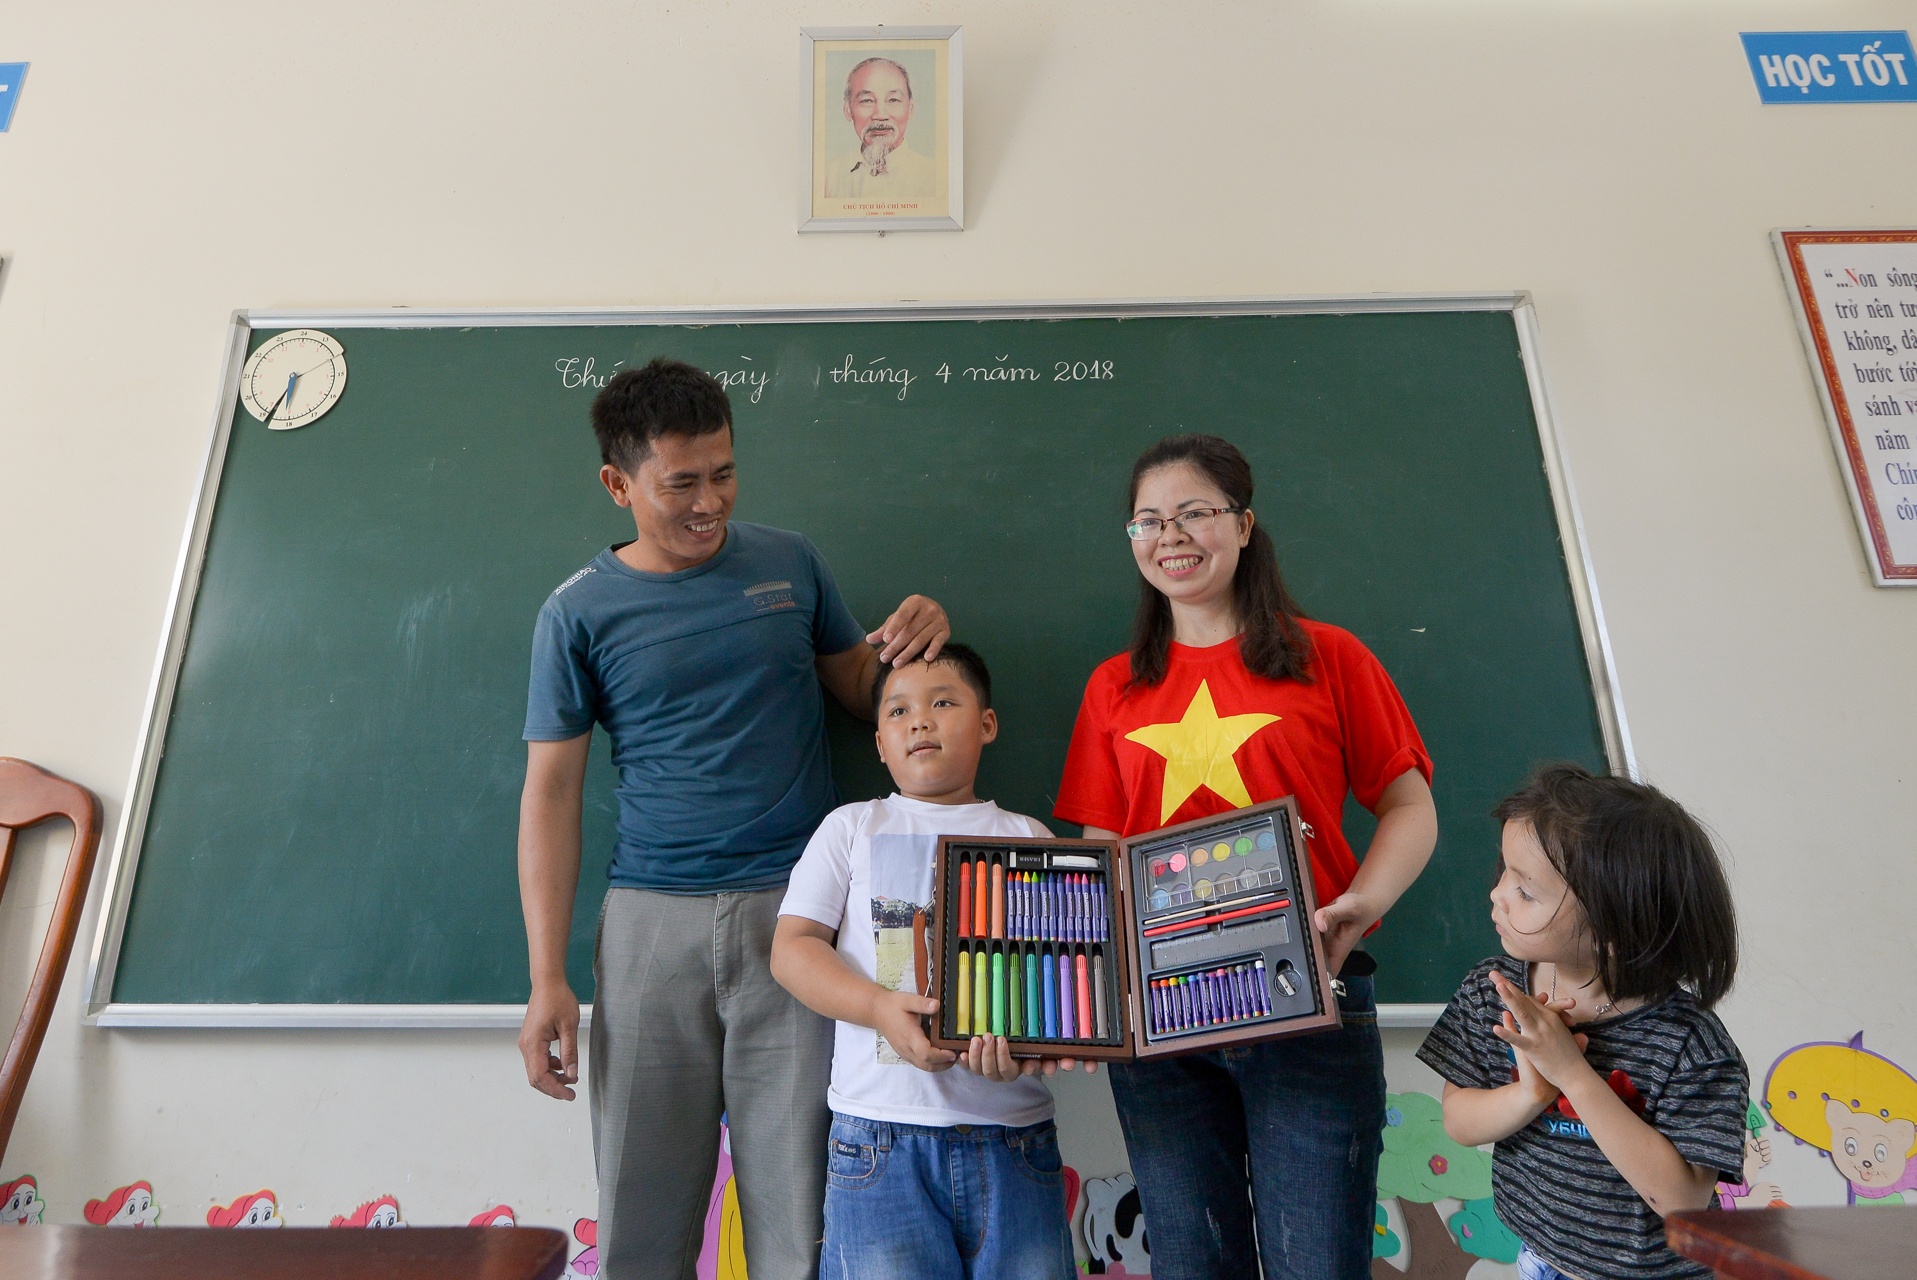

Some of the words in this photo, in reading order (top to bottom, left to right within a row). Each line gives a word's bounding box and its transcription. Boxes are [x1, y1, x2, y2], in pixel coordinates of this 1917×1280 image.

[1759, 53, 1836, 94] HỌC
[1837, 40, 1909, 86] TỐT
[1866, 298, 1895, 319] nên
[1843, 329, 1898, 356] không,
[829, 353, 918, 401] tháng
[935, 362, 953, 383] 4
[962, 353, 1041, 382] năm
[1053, 360, 1115, 382] 2018
[1853, 361, 1894, 383] bước
[1865, 394, 1902, 416] sánh
[1875, 428, 1911, 450] năm
[753, 593, 793, 606] G.Star
[769, 601, 796, 610] events
